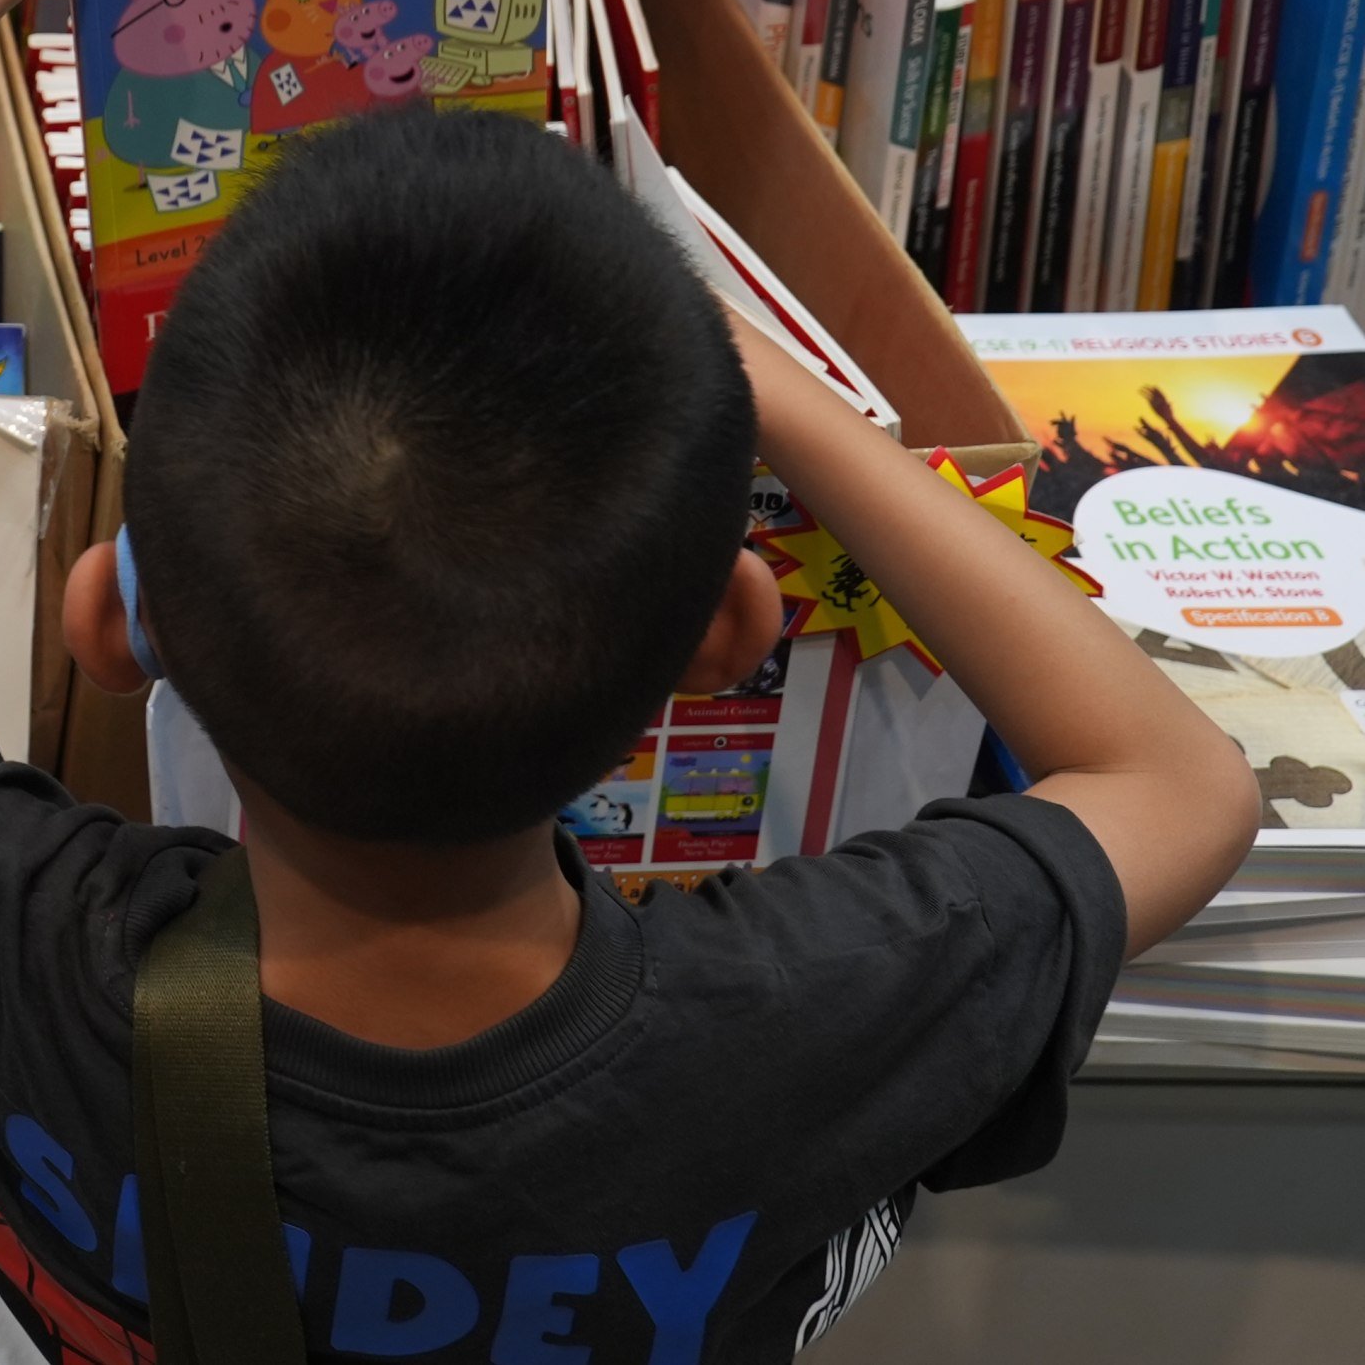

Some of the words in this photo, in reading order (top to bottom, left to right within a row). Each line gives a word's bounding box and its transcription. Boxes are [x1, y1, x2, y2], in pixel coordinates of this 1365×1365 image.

[904, 54, 922, 83] Skills
[901, 82, 918, 101] for
[134, 244, 189, 268] Level
[970, 337, 1013, 353] CSE
[1071, 335, 1190, 352] RELIGIOUS
[1196, 333, 1288, 350] STUDIES
[1112, 498, 1273, 527] Beliefs
[1105, 534, 1155, 562] in
[1171, 534, 1326, 562] Action
[1145, 569, 1209, 583] Victor
[1214, 569, 1241, 583] W.
[1245, 569, 1320, 583] Watton
[1165, 586, 1234, 600] Robert
[1236, 586, 1260, 600] M.
[1266, 586, 1325, 600] Stone
[1192, 608, 1310, 629] Specification
[1315, 609, 1331, 624] B
[683, 706, 729, 718] Animal
[729, 705, 769, 717] Colors
